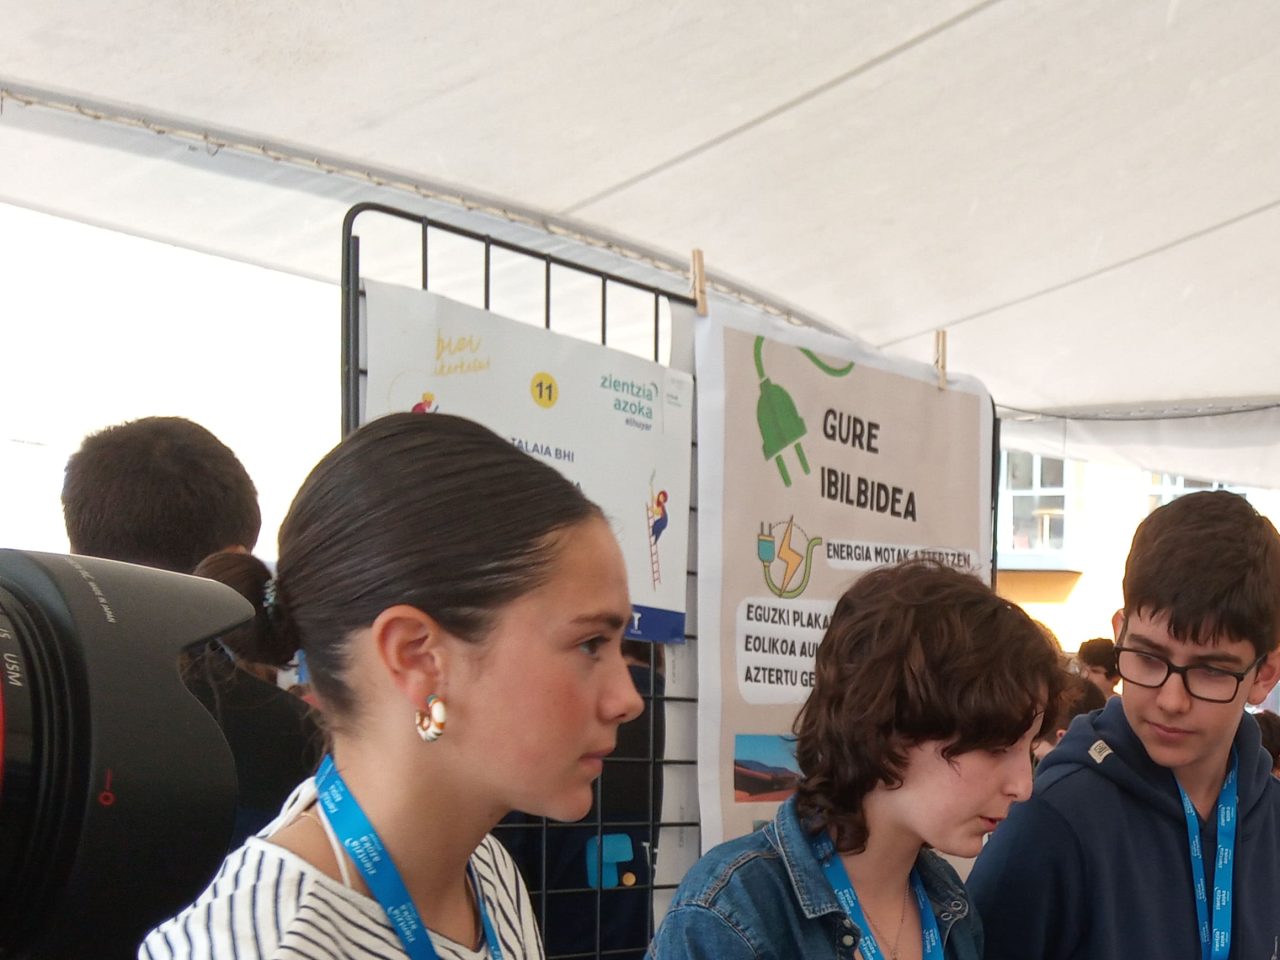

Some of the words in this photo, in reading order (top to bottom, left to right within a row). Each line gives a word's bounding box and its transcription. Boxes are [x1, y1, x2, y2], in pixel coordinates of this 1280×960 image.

[536, 382, 552, 401] 11
[600, 374, 653, 401] zientzia
[613, 398, 653, 419] azoka
[823, 408, 880, 454] GURE
[555, 448, 574, 462] BHI
[821, 466, 916, 522] IBILBIDEA
[826, 542, 872, 562] ENERGIA
[874, 546, 910, 563] MOTAK
[746, 604, 790, 626] EGUZKI
[792, 610, 834, 630] PLAKA
[745, 635, 797, 657] EOLIKOA
[3, 653, 23, 686] USM
[745, 666, 798, 686] AZTERTU
